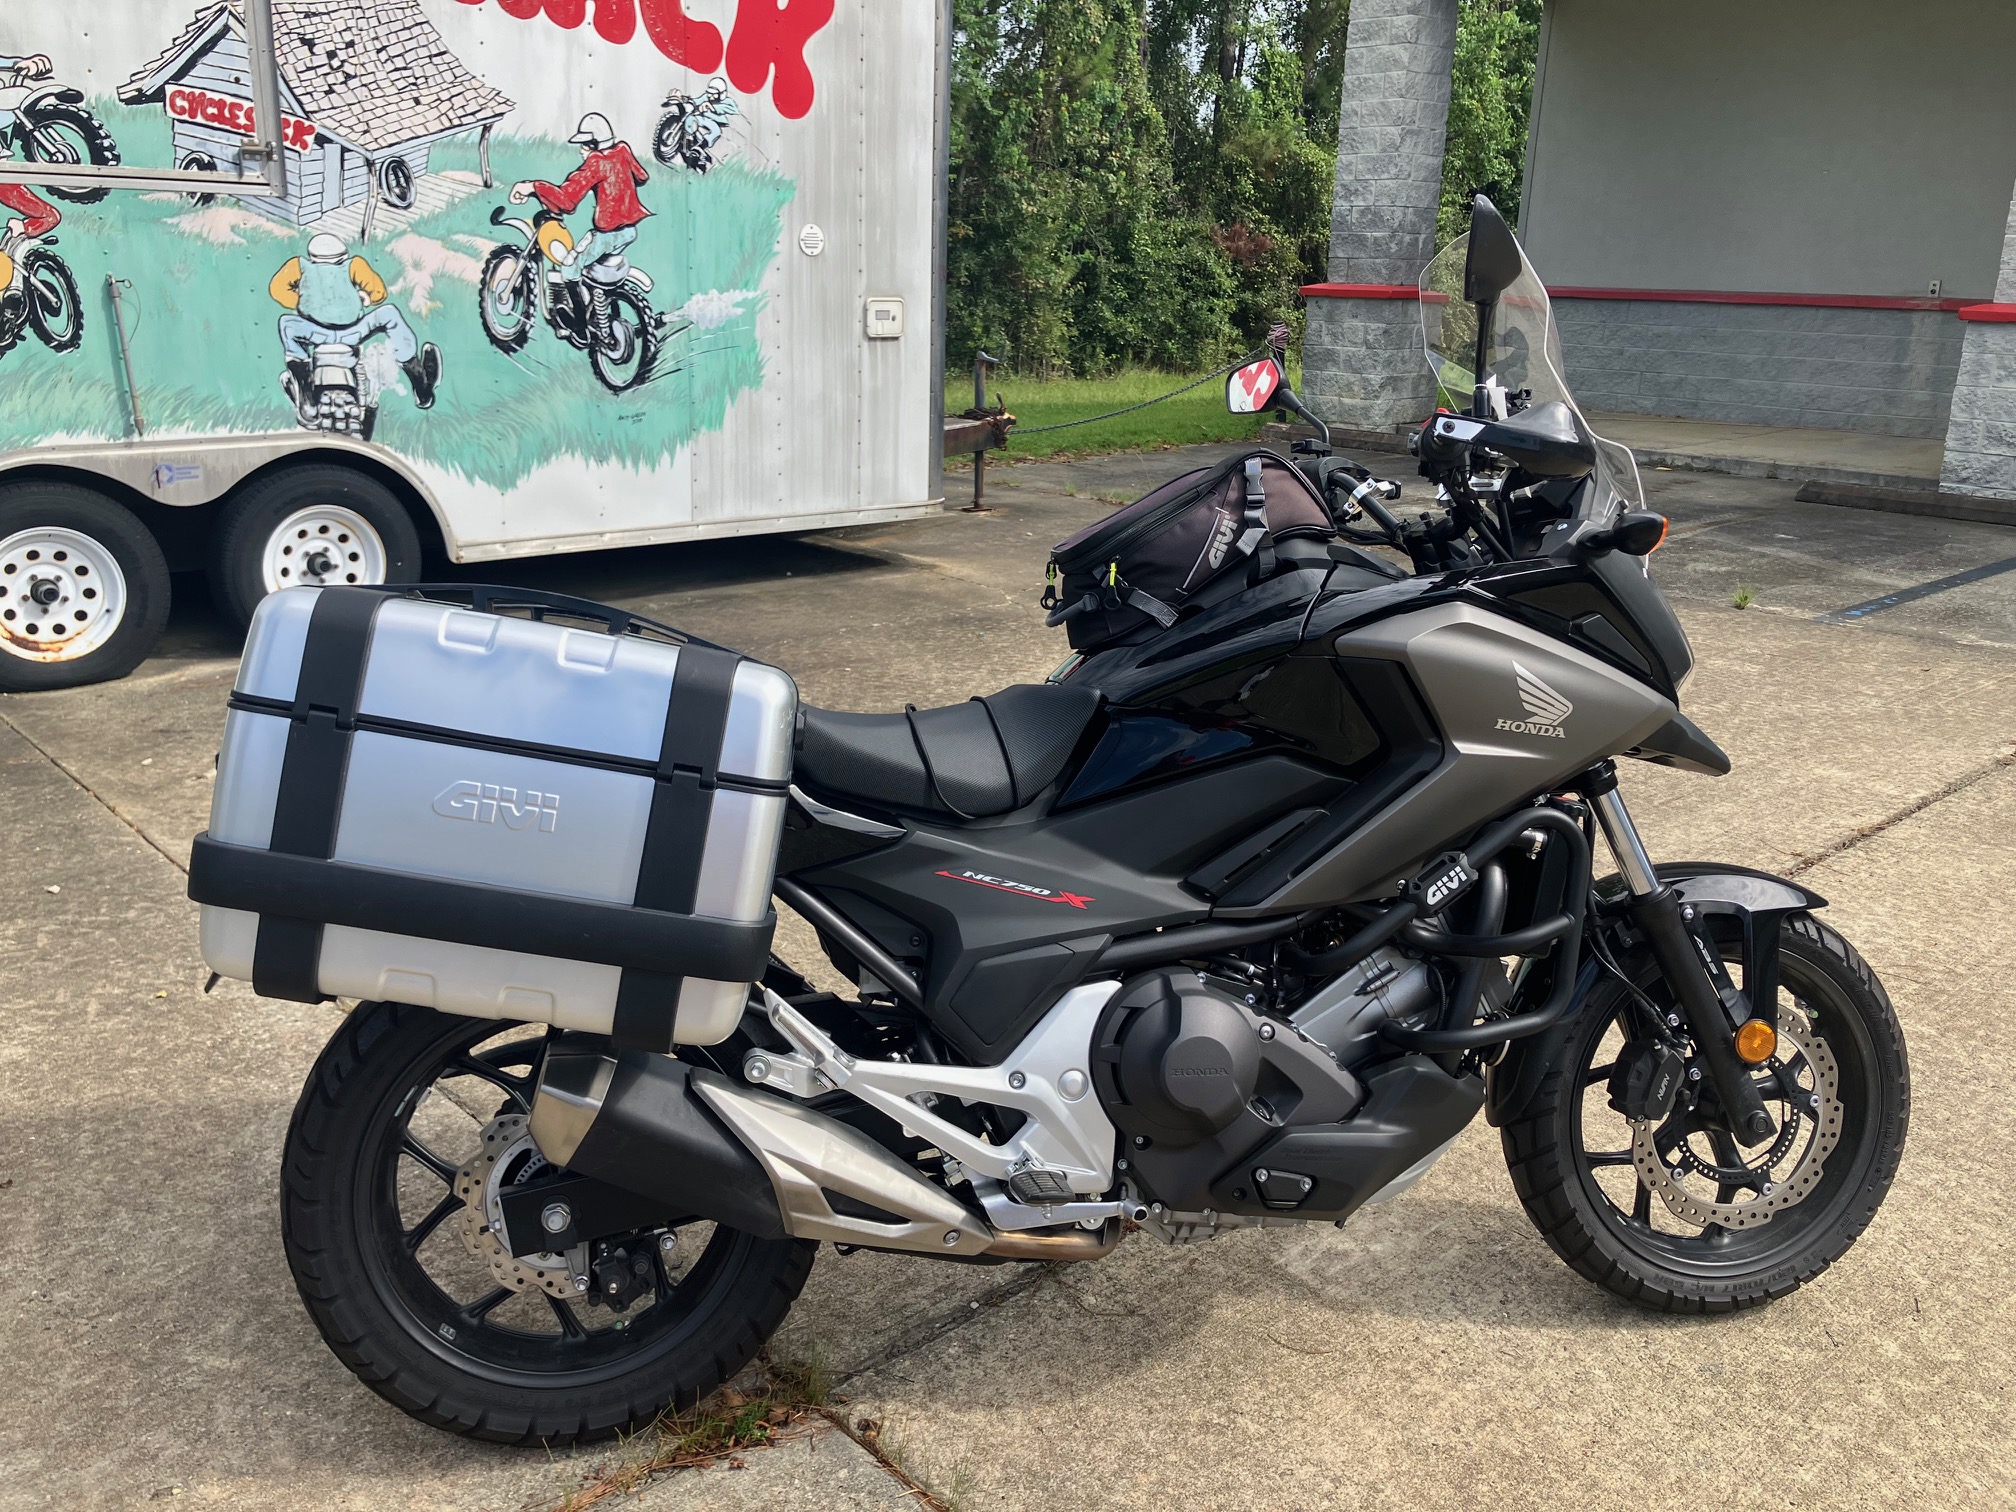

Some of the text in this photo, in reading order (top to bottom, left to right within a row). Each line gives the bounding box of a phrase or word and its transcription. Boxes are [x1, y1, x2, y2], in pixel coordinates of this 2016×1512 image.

[169, 89, 316, 151] CYCLESCK
[1208, 518, 1238, 570] GIVI
[1493, 718, 1566, 739] HONDA
[432, 780, 560, 833] GIVI
[1426, 865, 1468, 906] GIVI
[1171, 1067, 1230, 1078] HONDA
